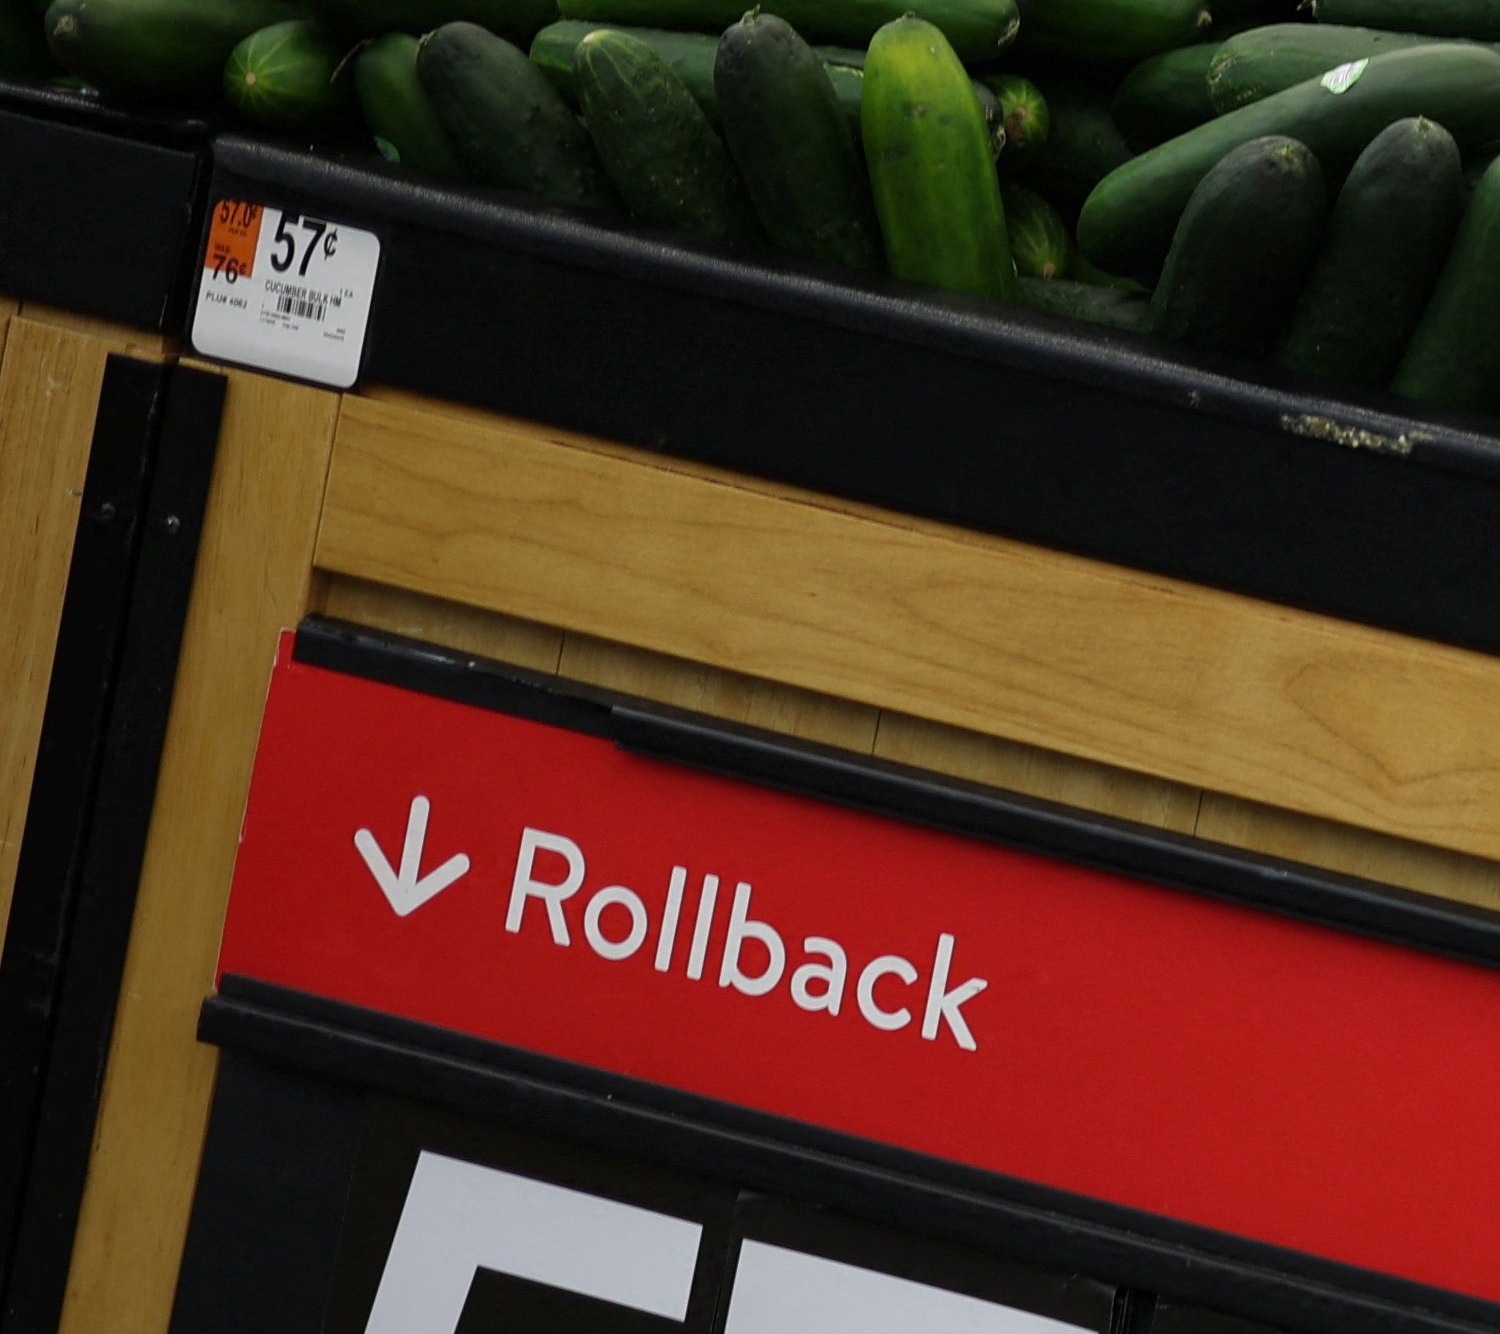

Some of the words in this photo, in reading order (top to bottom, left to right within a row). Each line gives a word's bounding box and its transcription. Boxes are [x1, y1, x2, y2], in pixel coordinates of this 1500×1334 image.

[212, 254, 248, 284] 76¢
[206, 291, 227, 304] PLU#
[265, 279, 307, 298] CUCUMBER
[308, 290, 328, 303] BULK
[329, 294, 342, 308] HM
[503, 823, 992, 1053] Rollback
